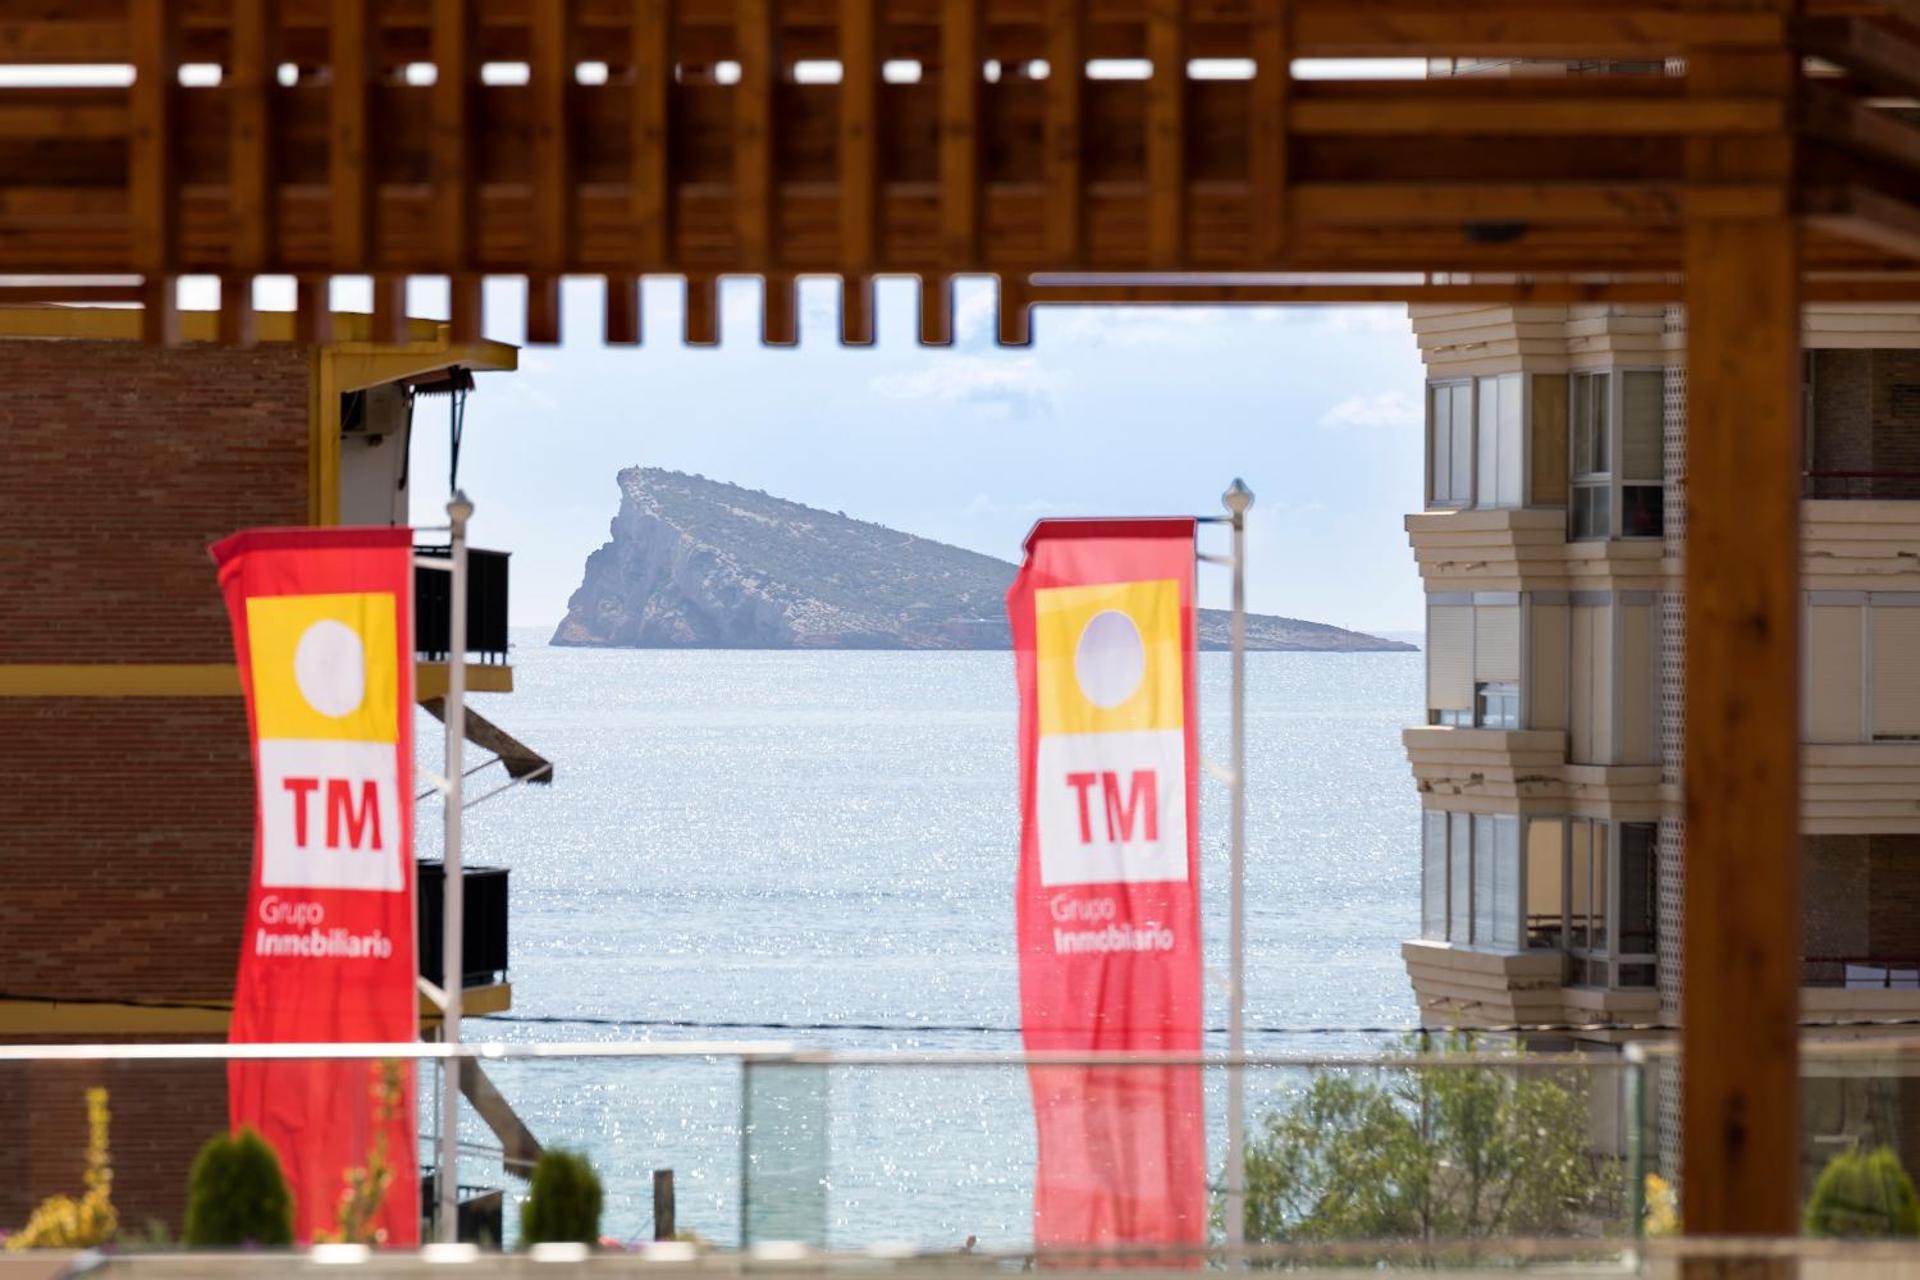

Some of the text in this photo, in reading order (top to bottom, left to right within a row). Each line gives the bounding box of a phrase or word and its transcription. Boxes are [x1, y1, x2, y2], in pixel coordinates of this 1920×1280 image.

[283, 778, 382, 849] TM
[1066, 770, 1158, 843] TM
[259, 894, 325, 930] Grupo
[1050, 893, 1116, 925] Grupo
[256, 928, 392, 958] Inmobiliario
